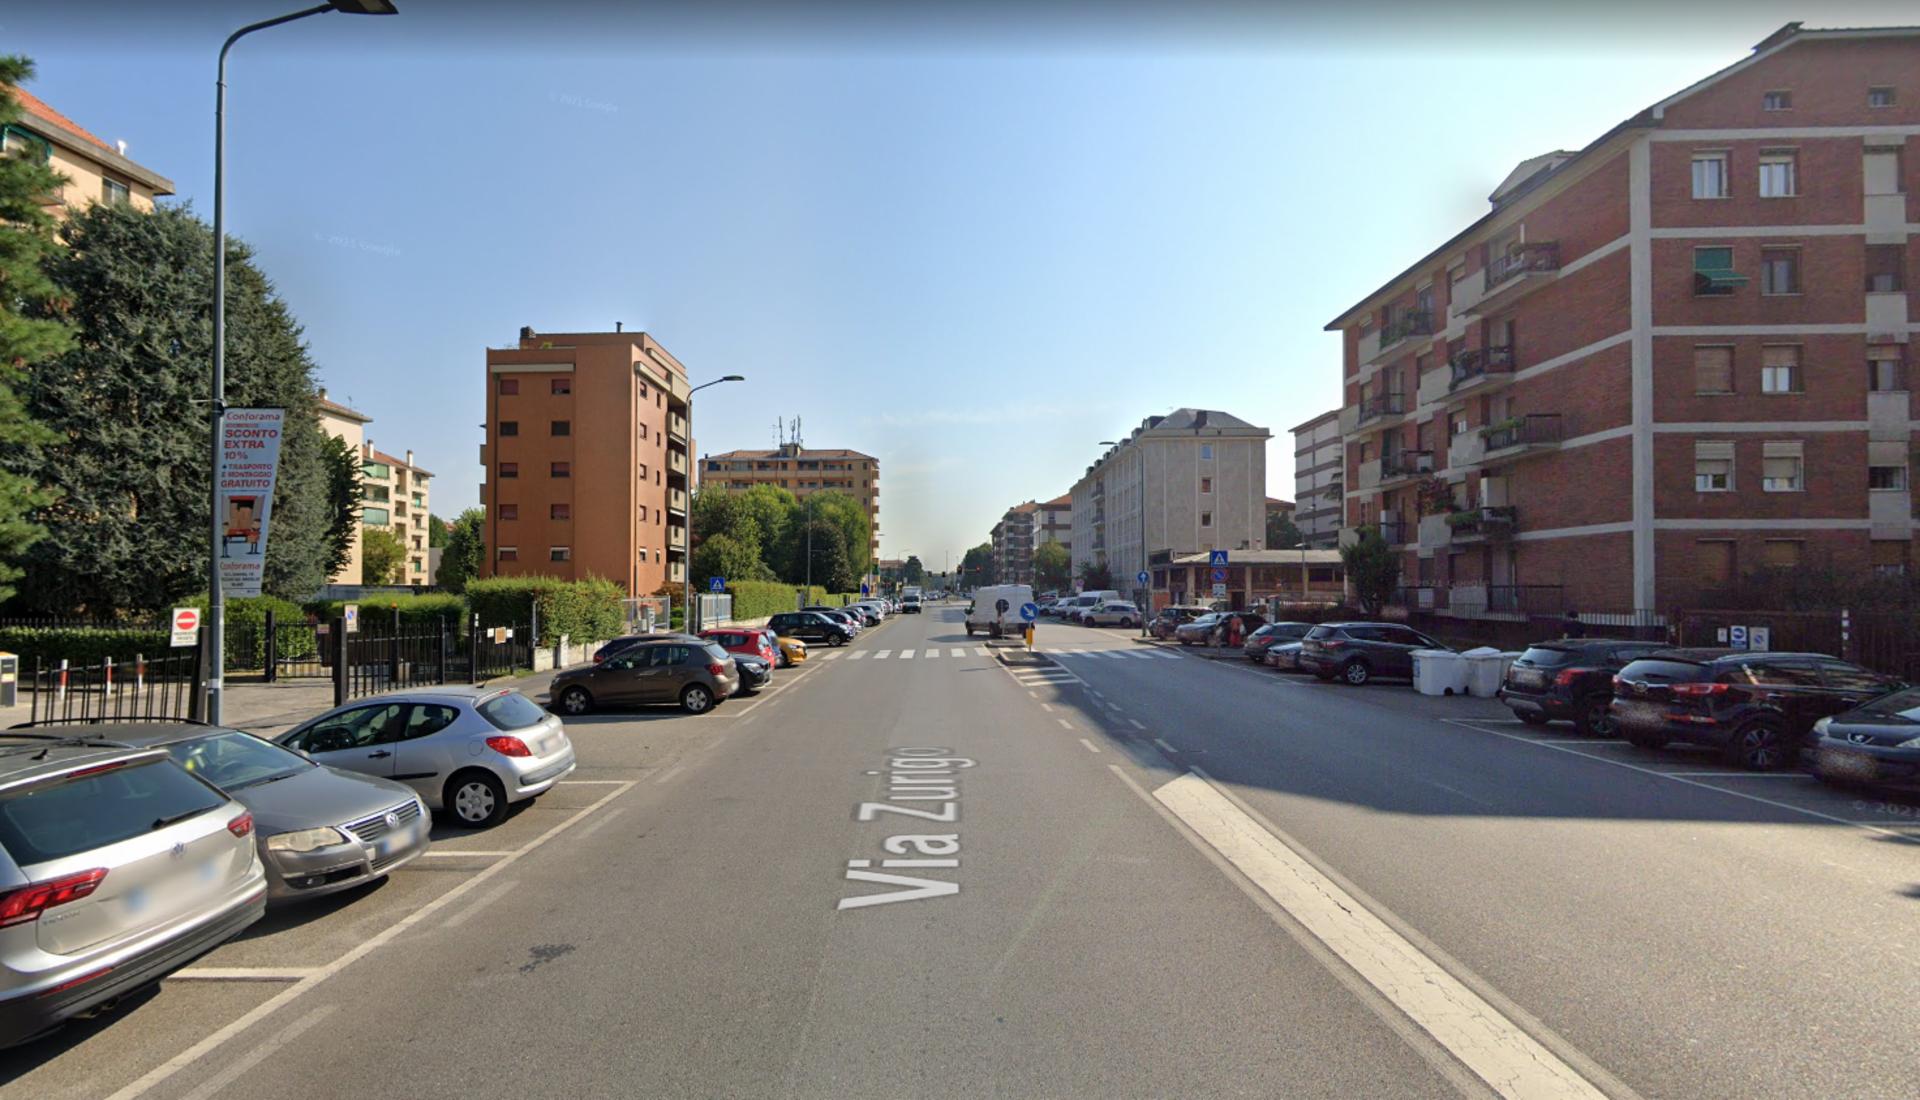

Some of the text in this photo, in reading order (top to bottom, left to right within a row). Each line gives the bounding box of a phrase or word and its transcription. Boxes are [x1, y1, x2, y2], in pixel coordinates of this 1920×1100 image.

[226, 411, 281, 422] Conforama
[225, 429, 279, 438] SCONTO
[224, 440, 265, 449] EXTRA
[224, 450, 249, 460] 10%
[228, 463, 273, 471] TRASPORTO
[220, 479, 271, 488] GRATUITO
